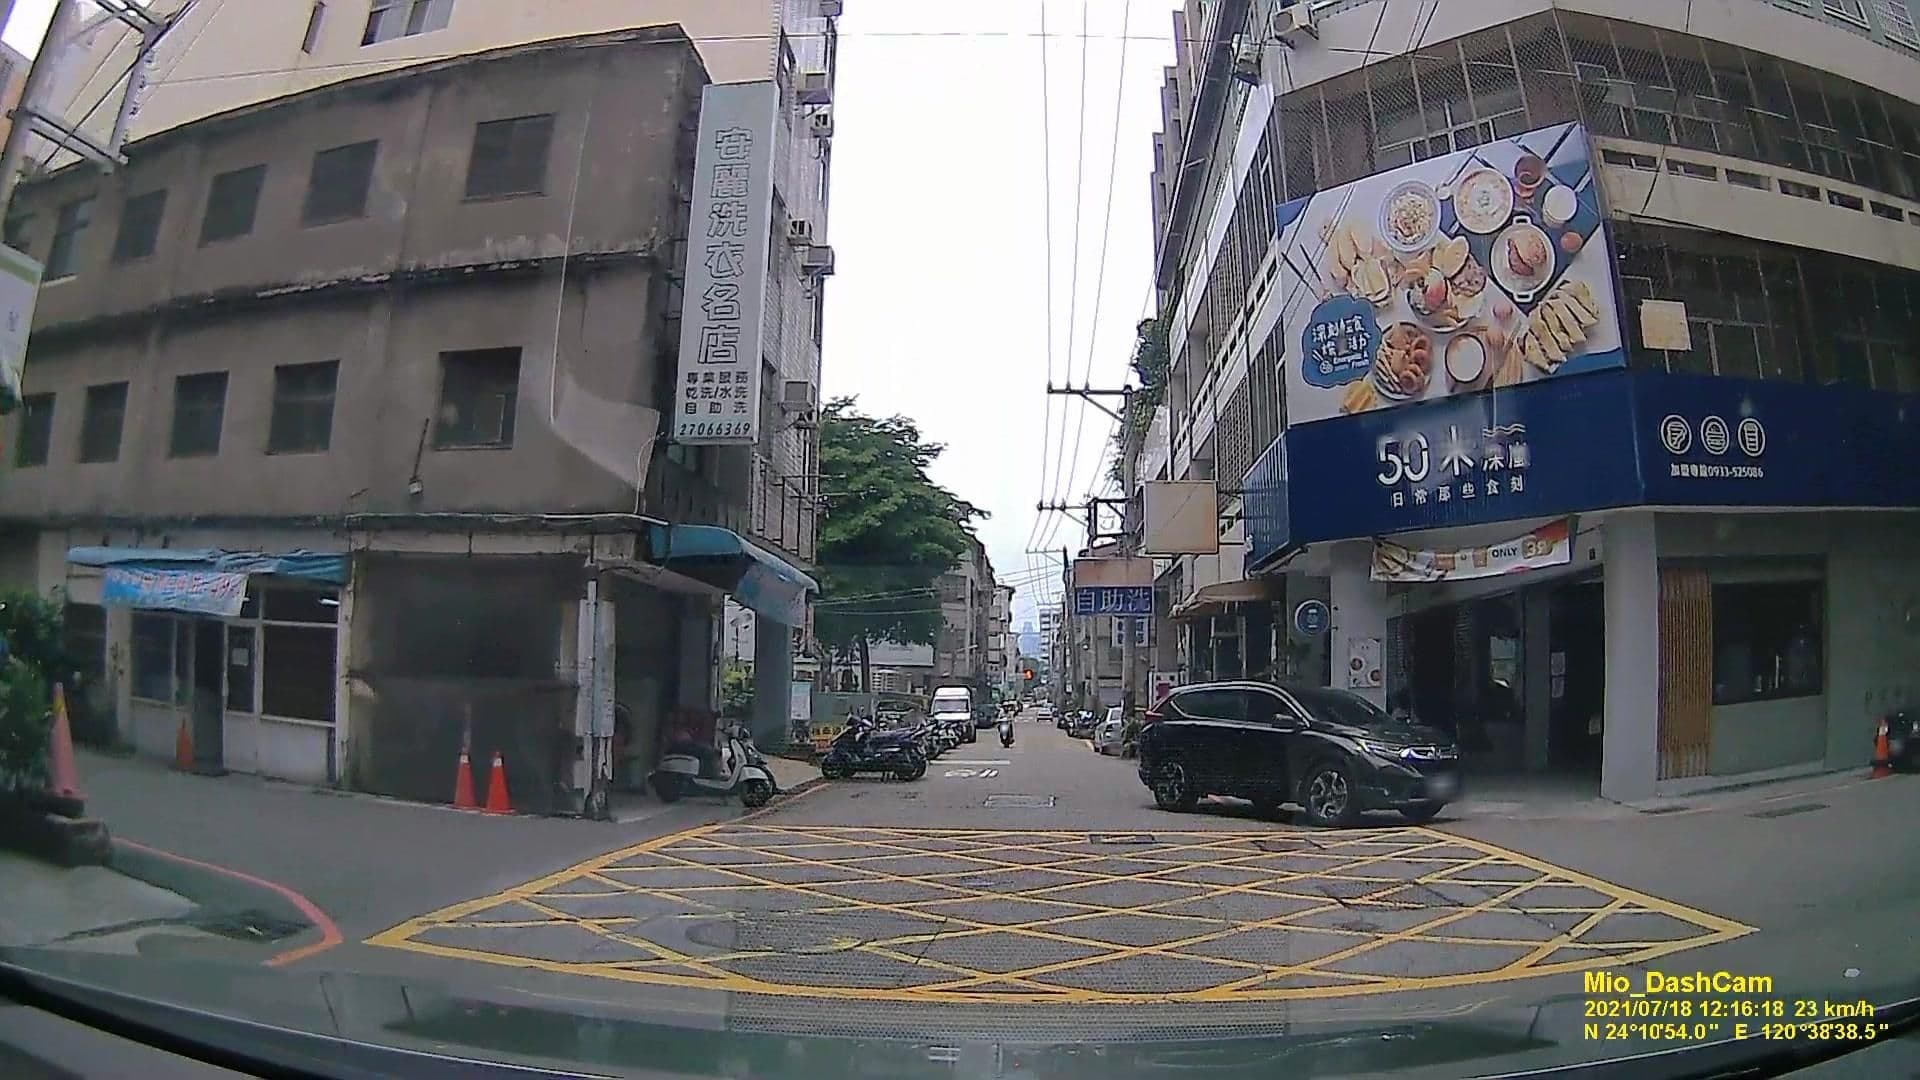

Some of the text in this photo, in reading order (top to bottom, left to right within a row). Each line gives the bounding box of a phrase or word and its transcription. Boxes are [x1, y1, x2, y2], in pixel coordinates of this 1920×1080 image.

[685, 401, 747, 415] 自助洗
[679, 422, 751, 436] 27066369
[1392, 475, 1524, 508] 日常那些食刻
[1491, 547, 1518, 558] ONLY
[1076, 588, 1151, 613] 自助洗
